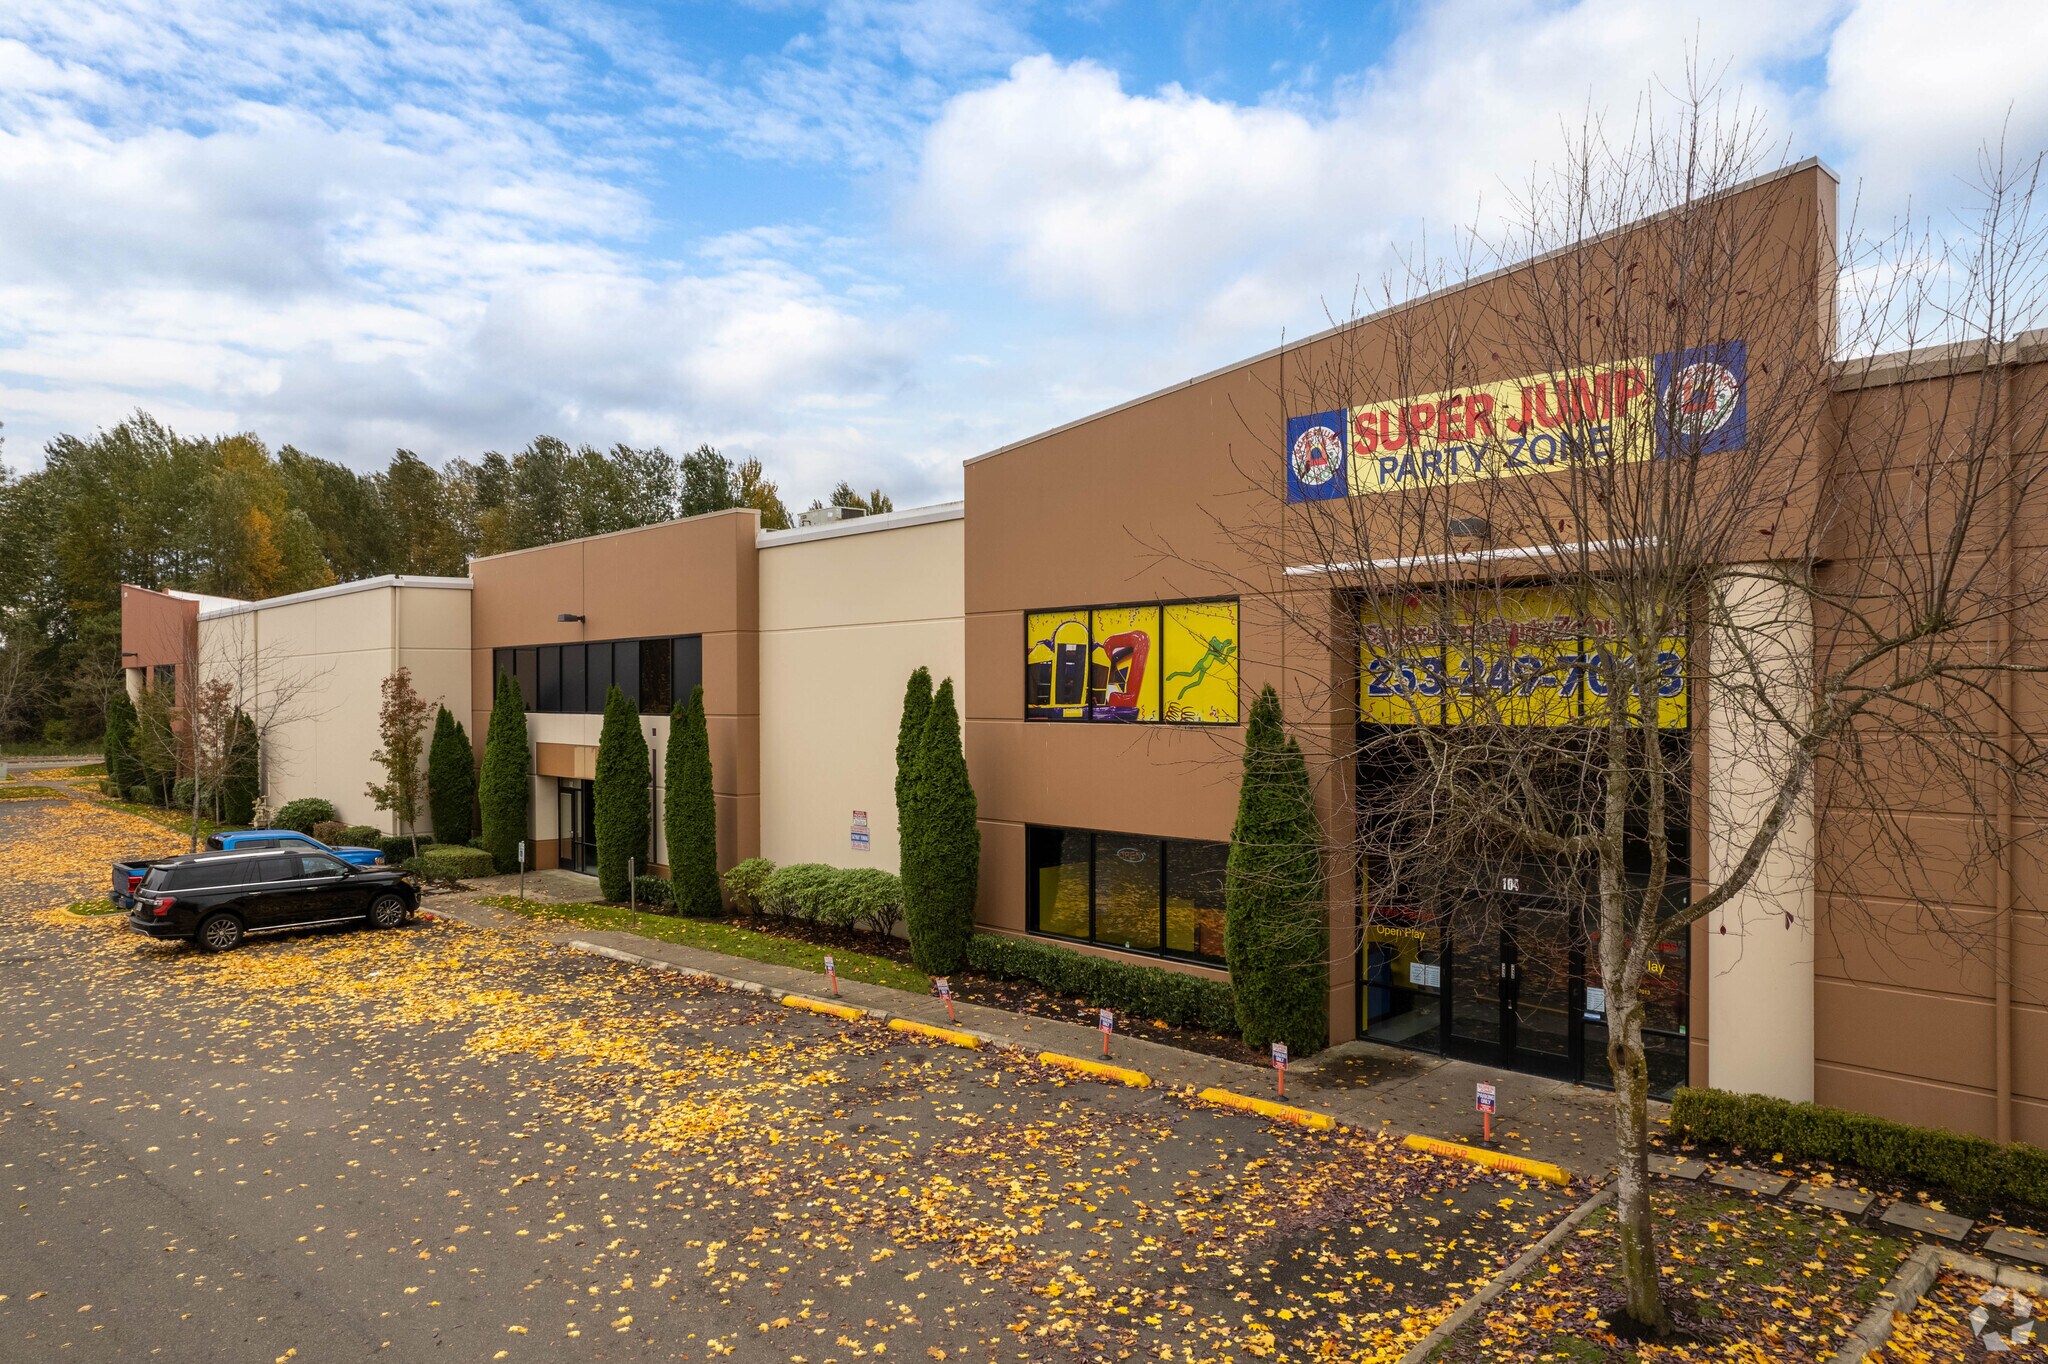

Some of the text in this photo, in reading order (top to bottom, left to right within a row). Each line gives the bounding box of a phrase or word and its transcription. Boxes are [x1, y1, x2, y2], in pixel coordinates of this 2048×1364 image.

[1353, 393, 1495, 455] SUPER
[1505, 368, 1646, 434] JUMP
[1379, 425, 1612, 484] PARTY ZONE
[1376, 924, 1426, 942] Open Play
[1647, 960, 1665, 975] lay
